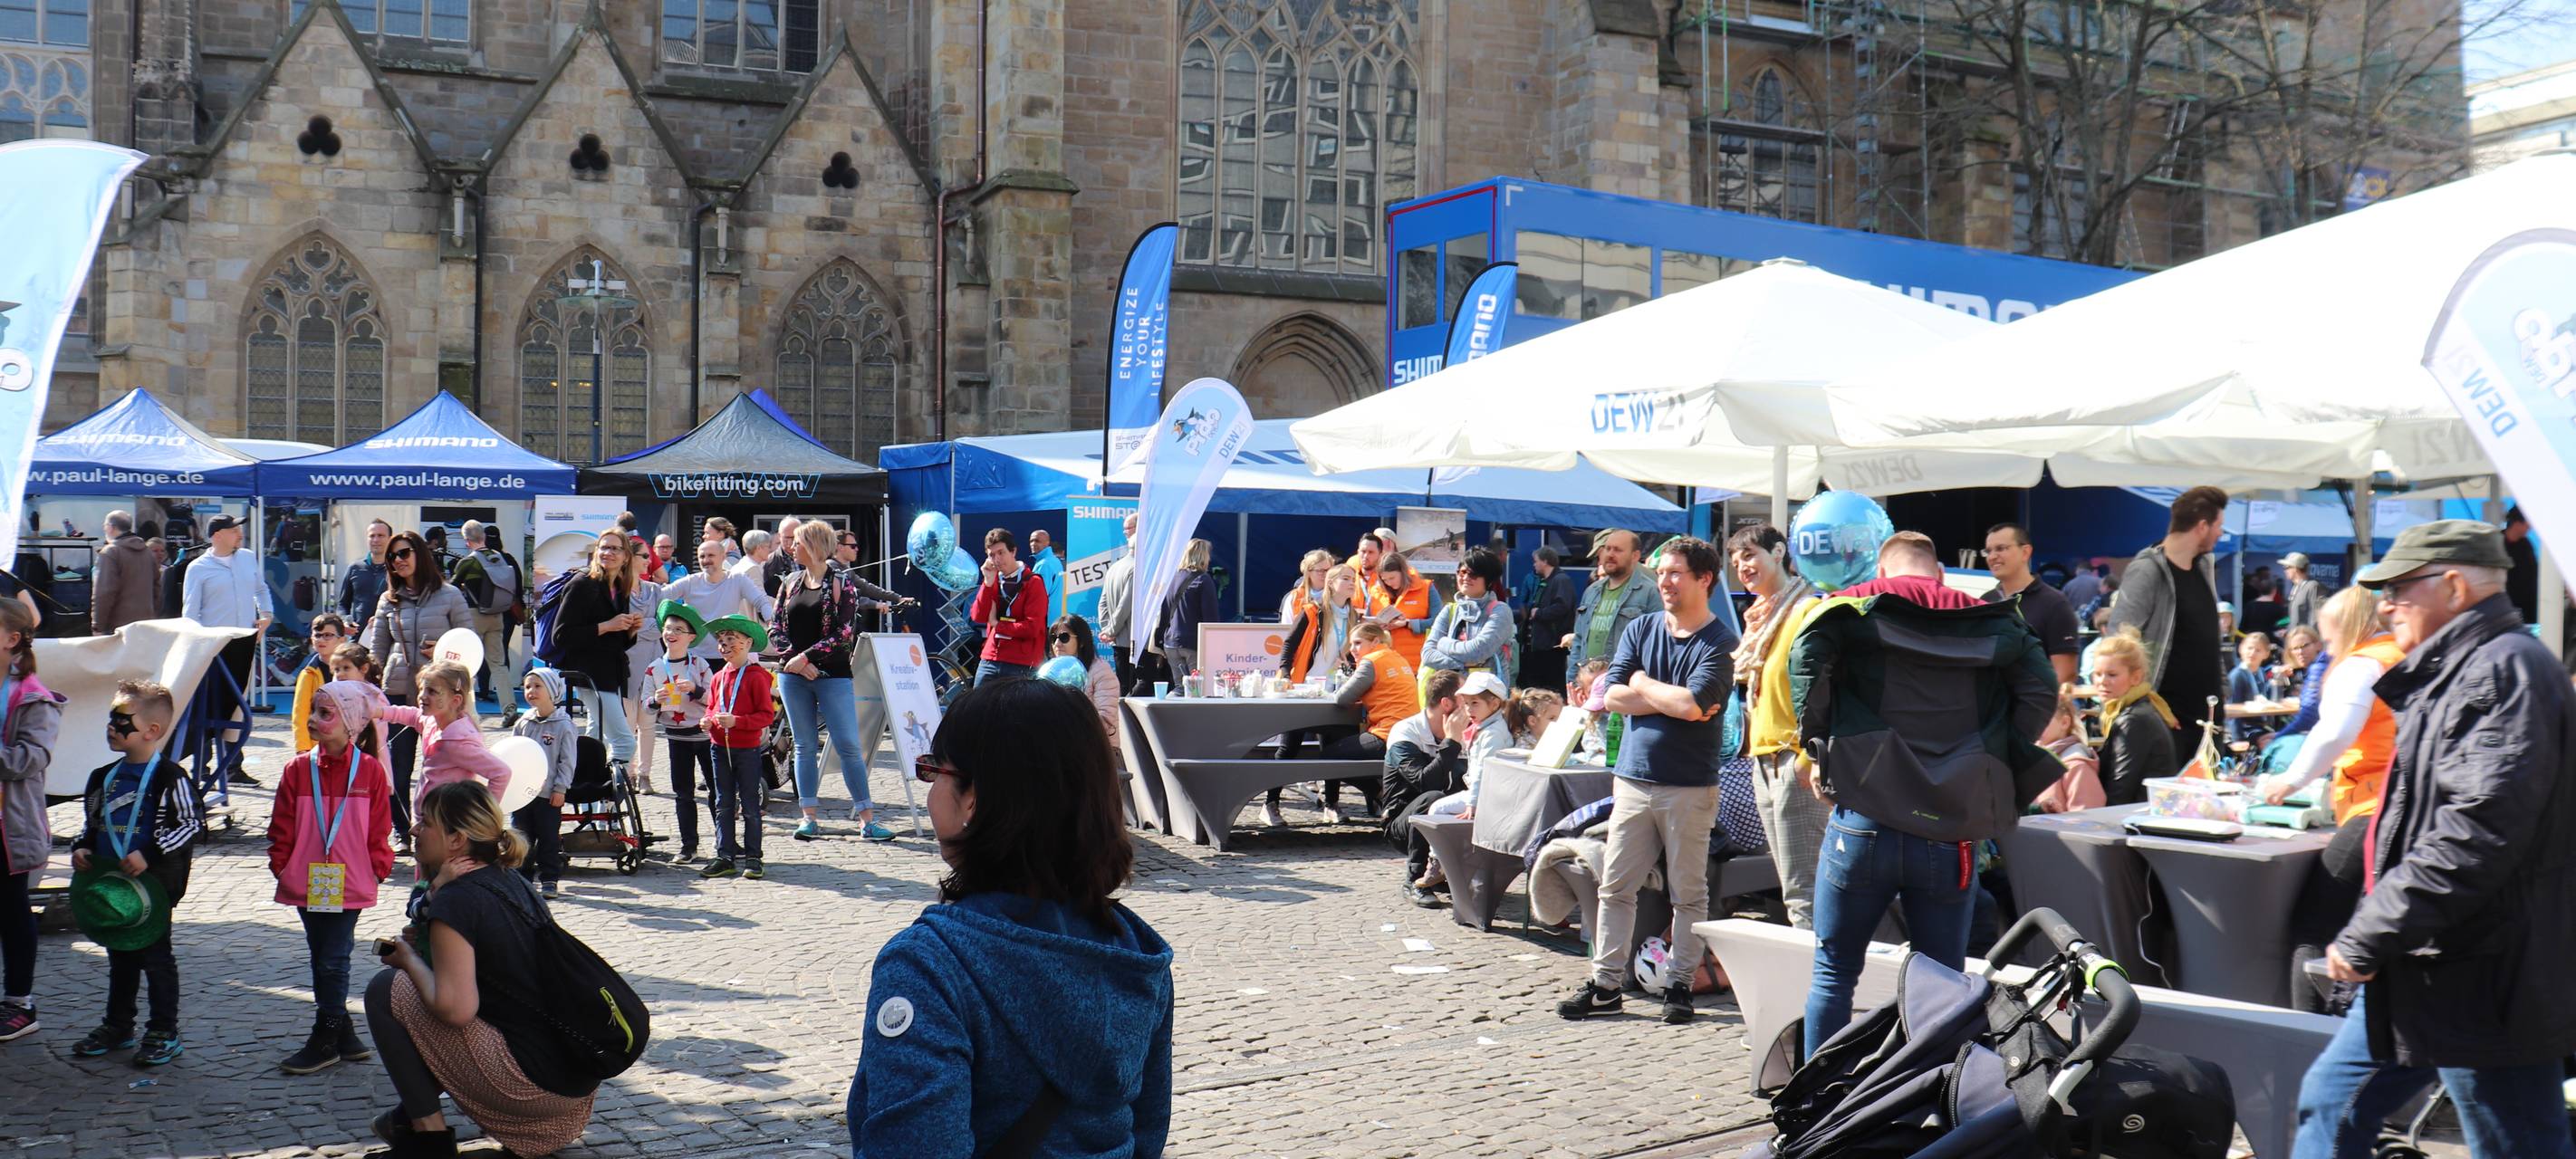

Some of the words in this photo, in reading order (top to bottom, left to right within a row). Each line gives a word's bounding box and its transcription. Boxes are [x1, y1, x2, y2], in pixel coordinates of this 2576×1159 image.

[1120, 286, 1139, 379] ENERGIZE
[1136, 316, 1151, 367] YOUR
[1150, 302, 1165, 397] LIFESTYLE
[1393, 354, 1445, 384] SHIM
[43, 433, 188, 446] SHIMANO
[364, 436, 499, 449] SHIMANO
[27, 468, 205, 486] w.paul-lange.de
[310, 472, 525, 490] www.paul-lange.de
[665, 475, 803, 493] bikefitting.com
[1071, 560, 1111, 586] TEST
[1226, 653, 1267, 663] Kinder-
[895, 681, 919, 691] station
